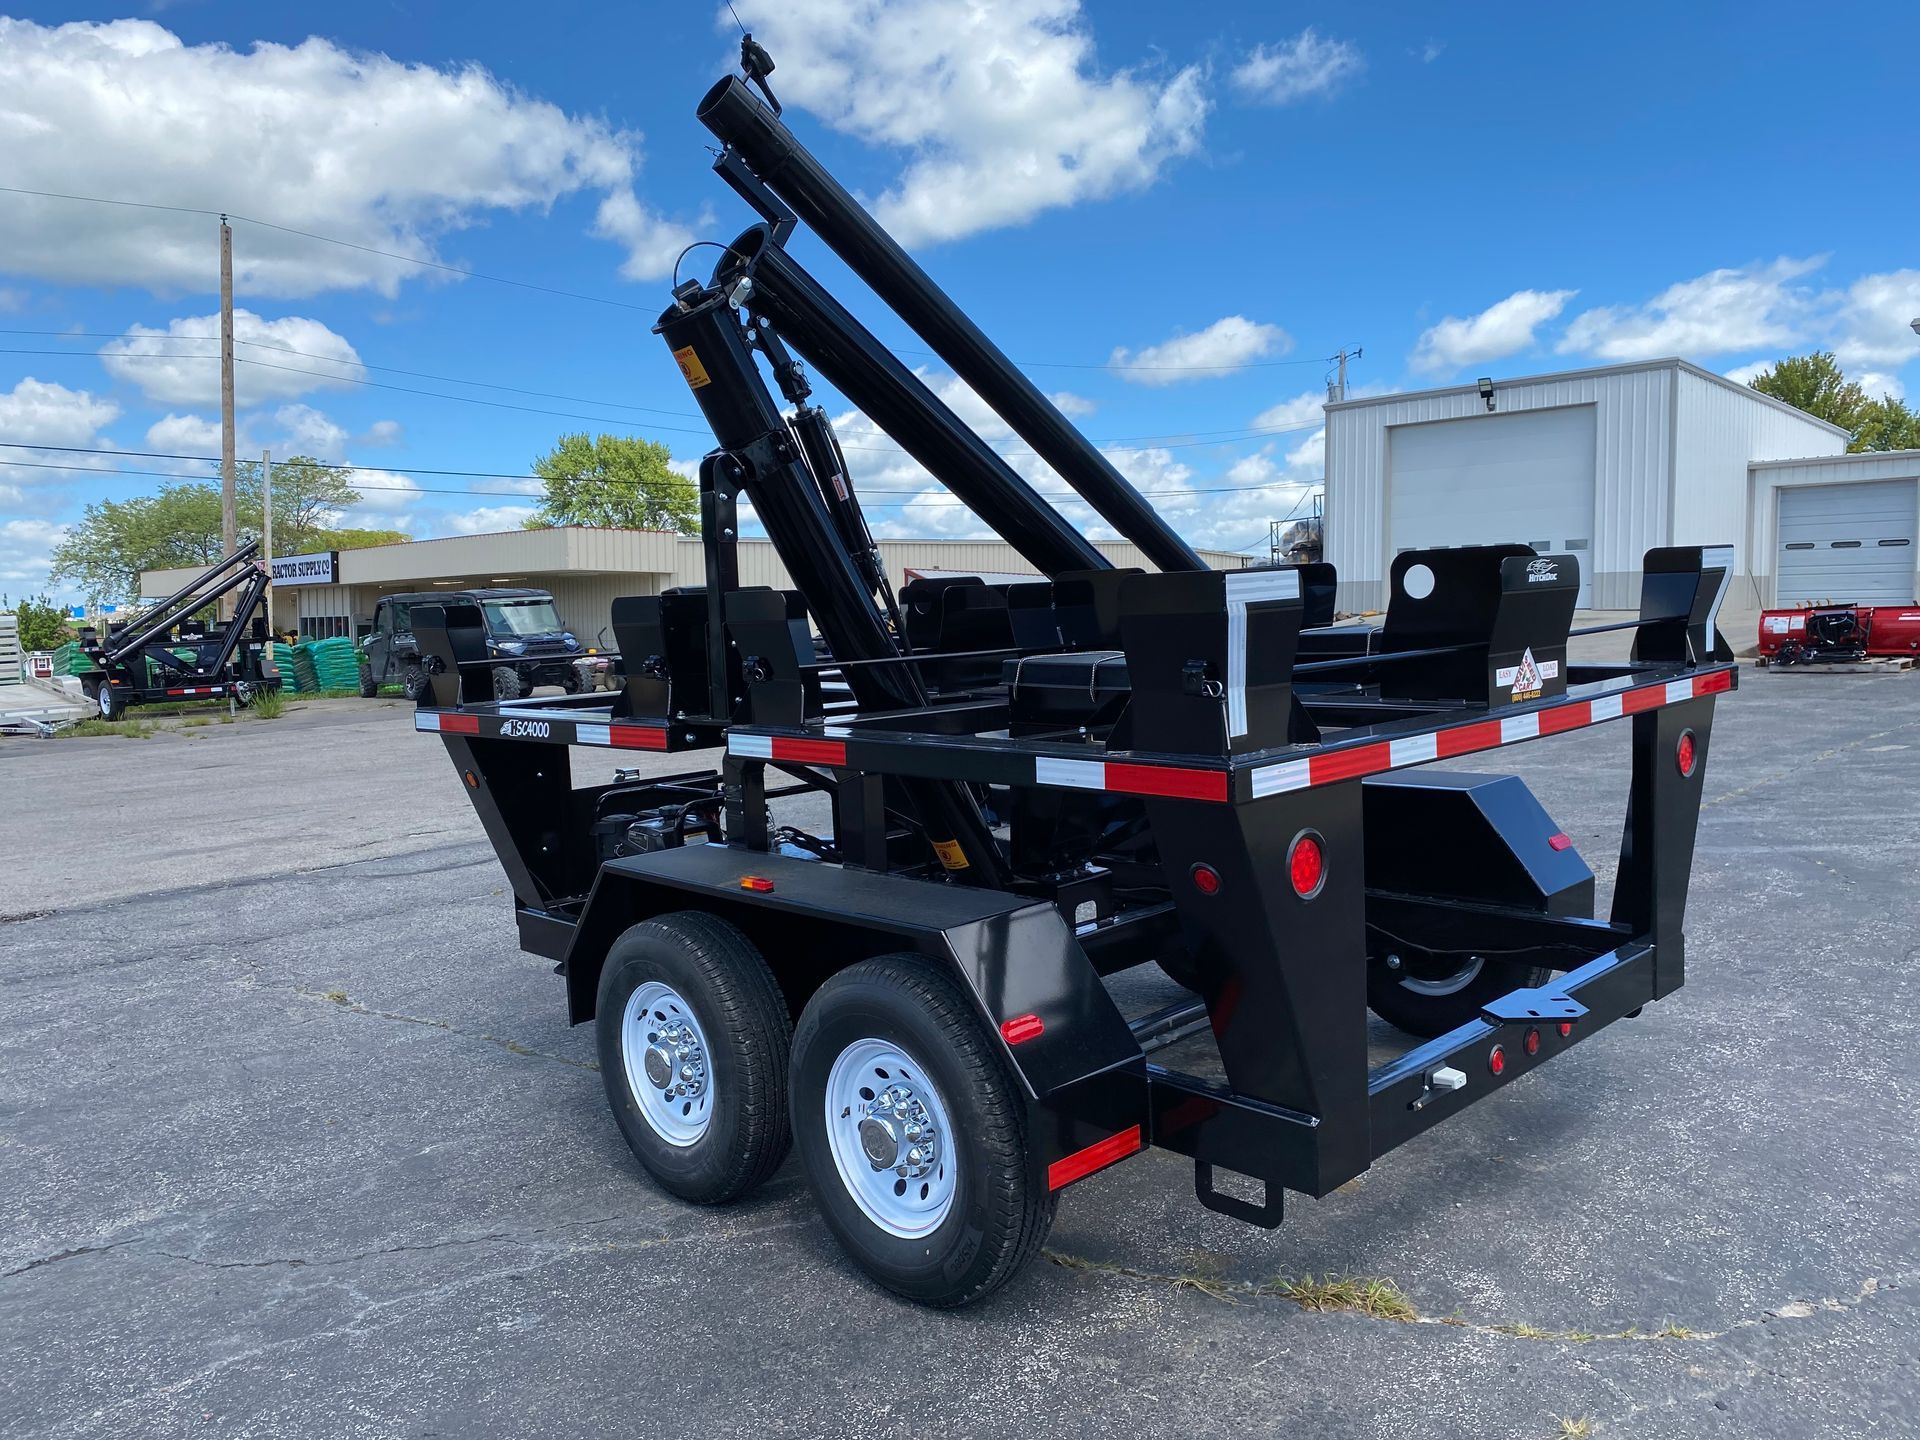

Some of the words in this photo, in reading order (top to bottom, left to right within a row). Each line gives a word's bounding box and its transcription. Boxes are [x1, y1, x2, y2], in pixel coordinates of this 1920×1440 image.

[273, 563, 297, 579] RACTOR
[298, 560, 321, 577] SUPPLY
[1542, 662, 1556, 671] LOAD
[1499, 670, 1511, 679] EASY
[1518, 682, 1534, 691] CART
